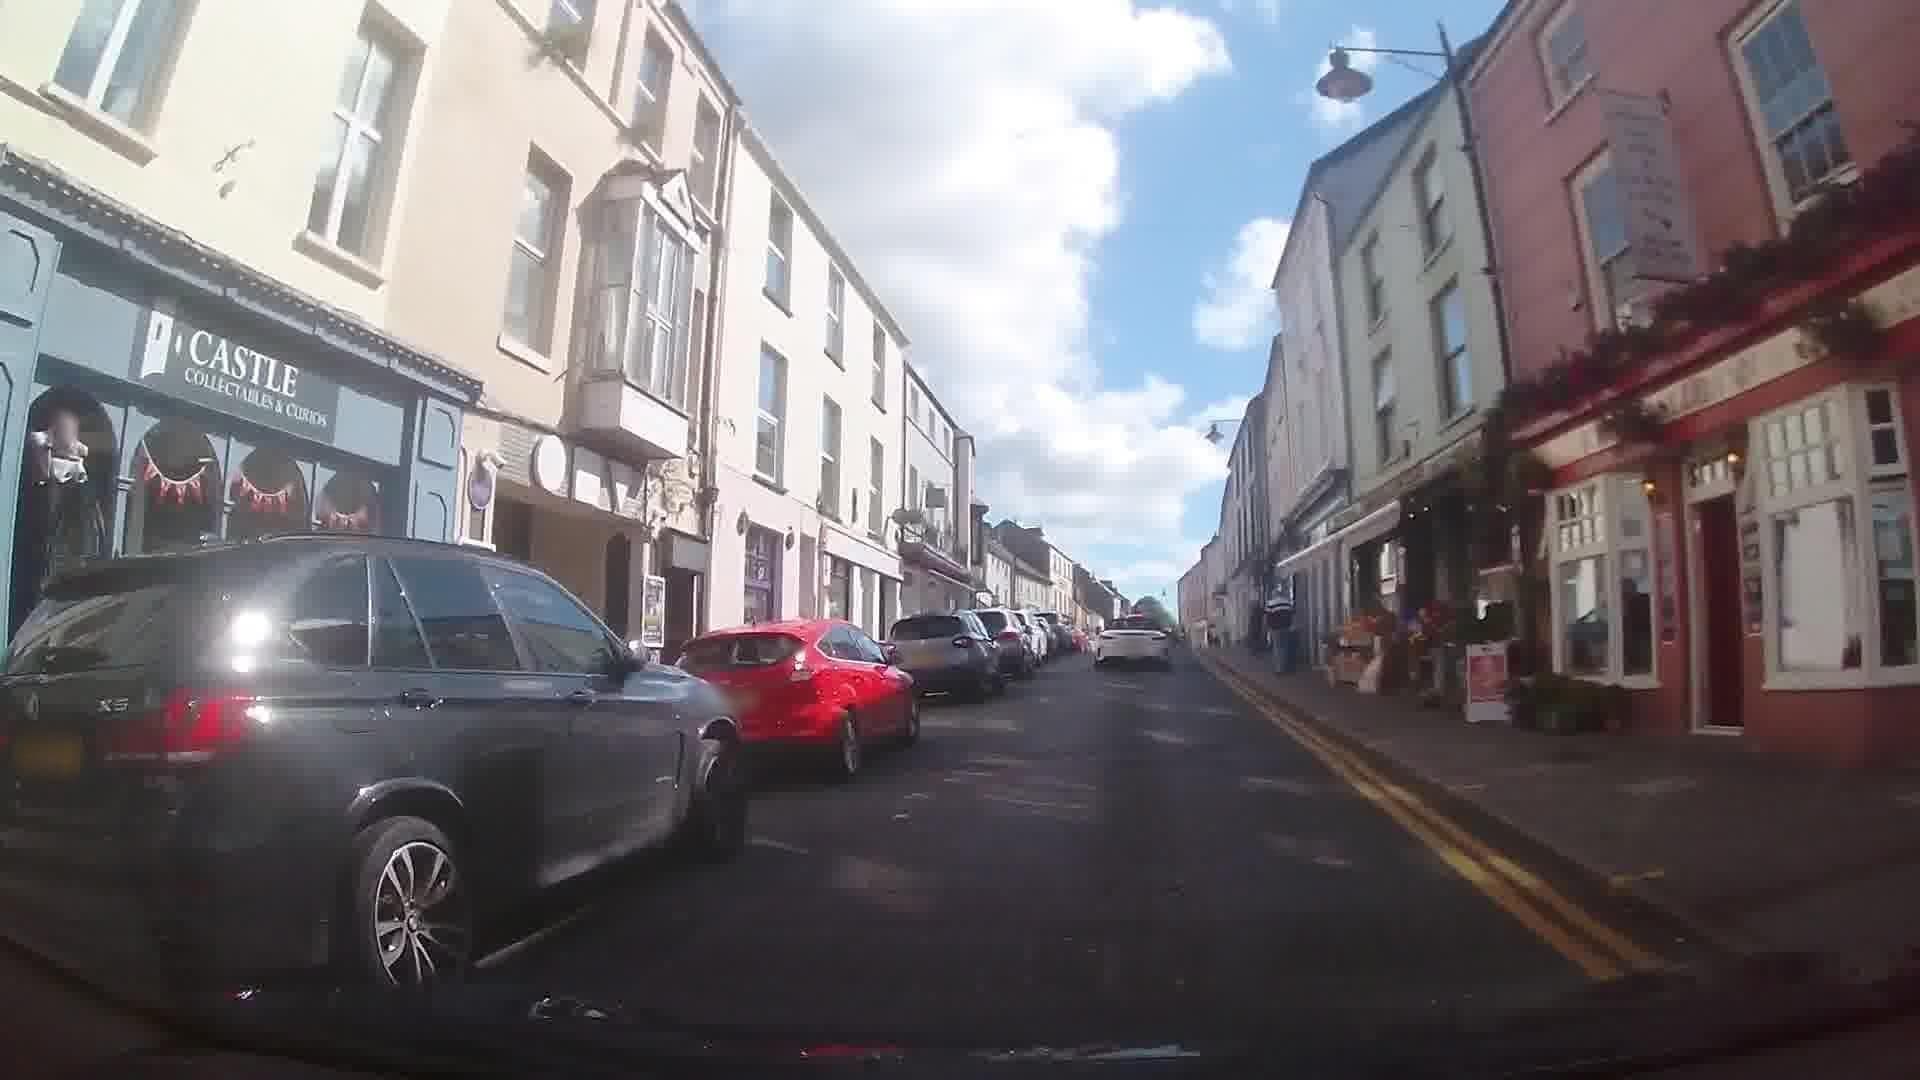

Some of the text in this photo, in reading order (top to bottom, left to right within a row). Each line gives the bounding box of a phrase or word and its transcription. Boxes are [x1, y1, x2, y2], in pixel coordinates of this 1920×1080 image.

[190, 330, 299, 398] CASTLE
[184, 367, 328, 427] COLLECTABLES & CURIOS
[96, 698, 129, 712] X5
